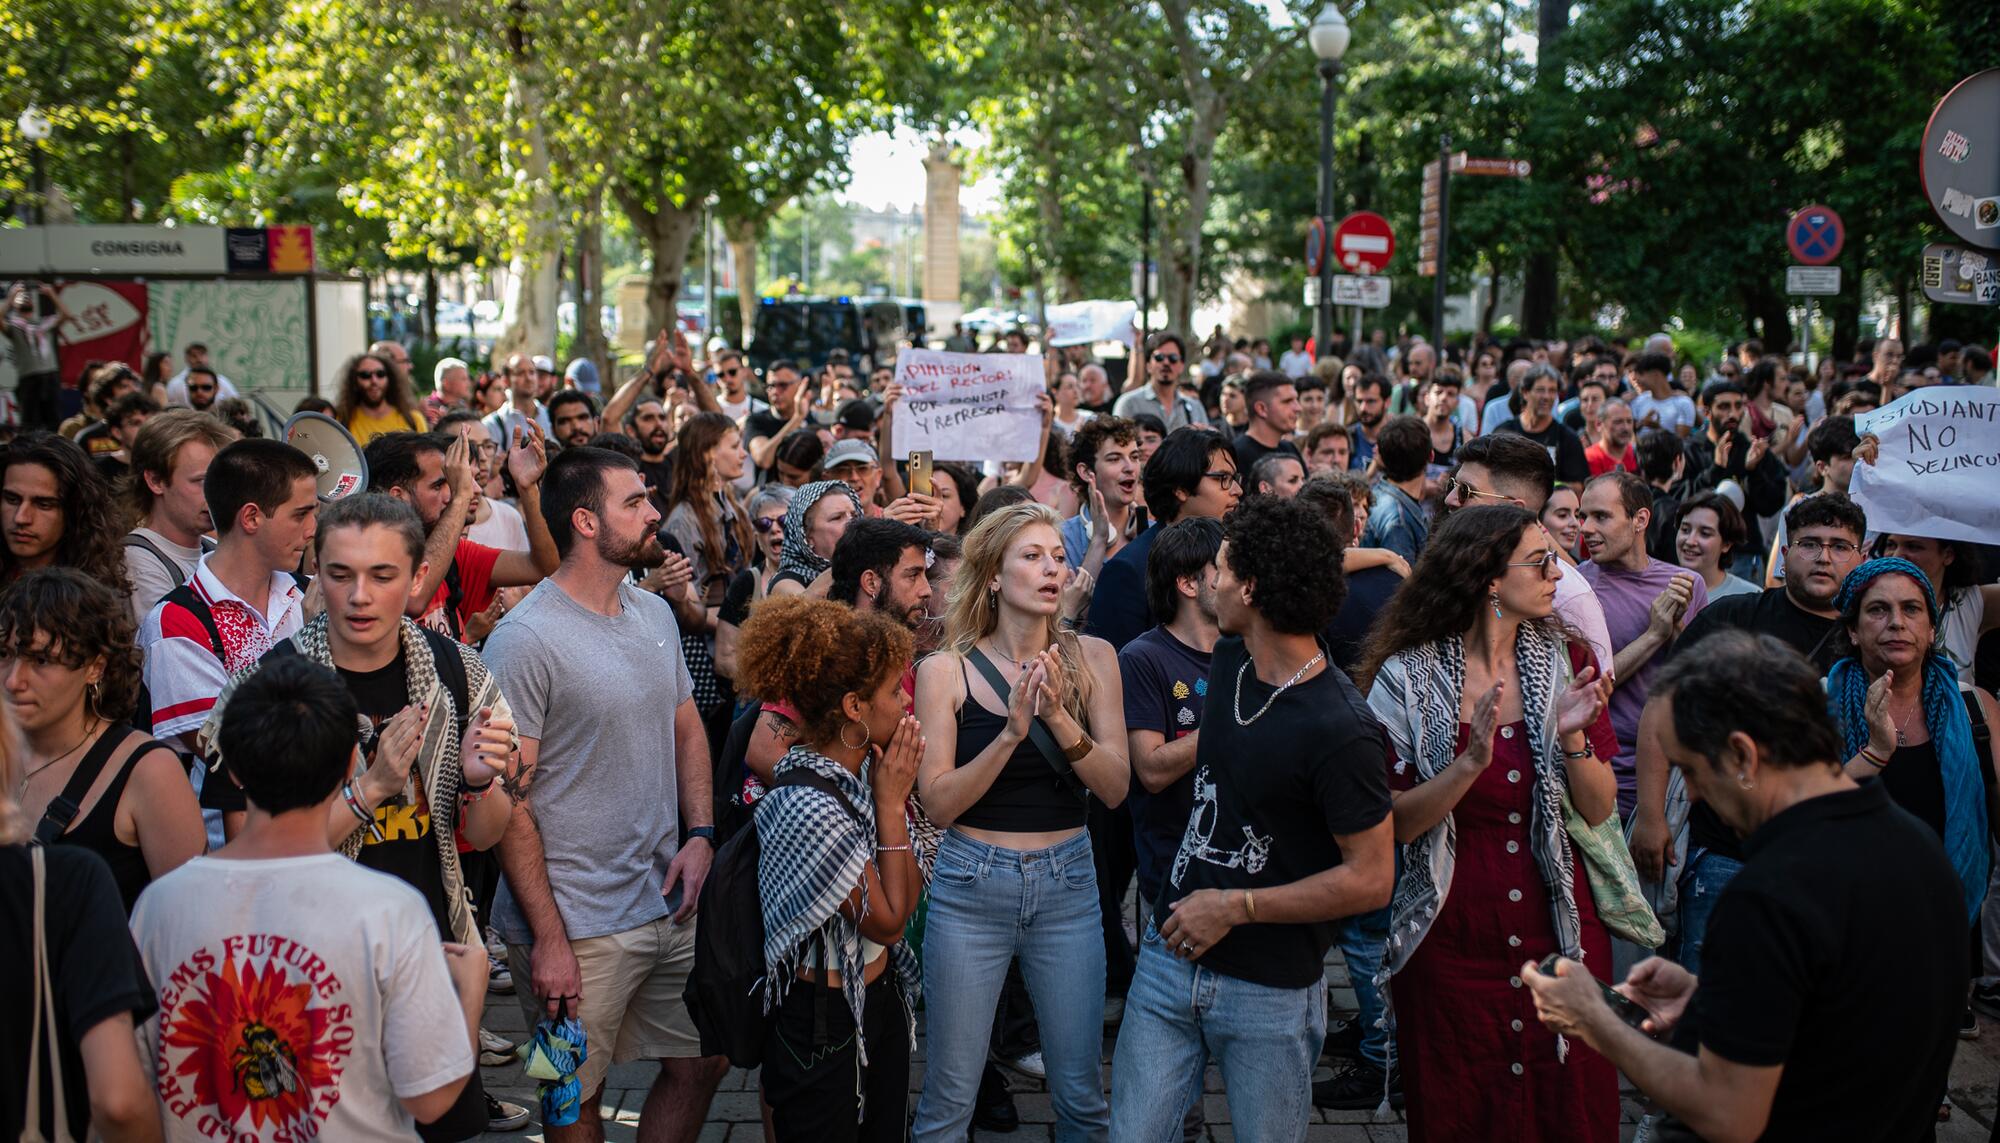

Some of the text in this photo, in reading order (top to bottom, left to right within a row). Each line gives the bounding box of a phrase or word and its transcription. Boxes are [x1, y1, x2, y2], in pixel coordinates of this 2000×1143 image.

[91, 240, 185, 256] CONSIGNA
[907, 369, 1013, 396] DEL RECTOR!
[908, 400, 942, 417] POR
[915, 404, 1006, 435] Y REPRESOR
[1907, 423, 1956, 454] NO
[1906, 453, 2000, 475] DELINCU
[222, 934, 342, 1000] FUTURE
